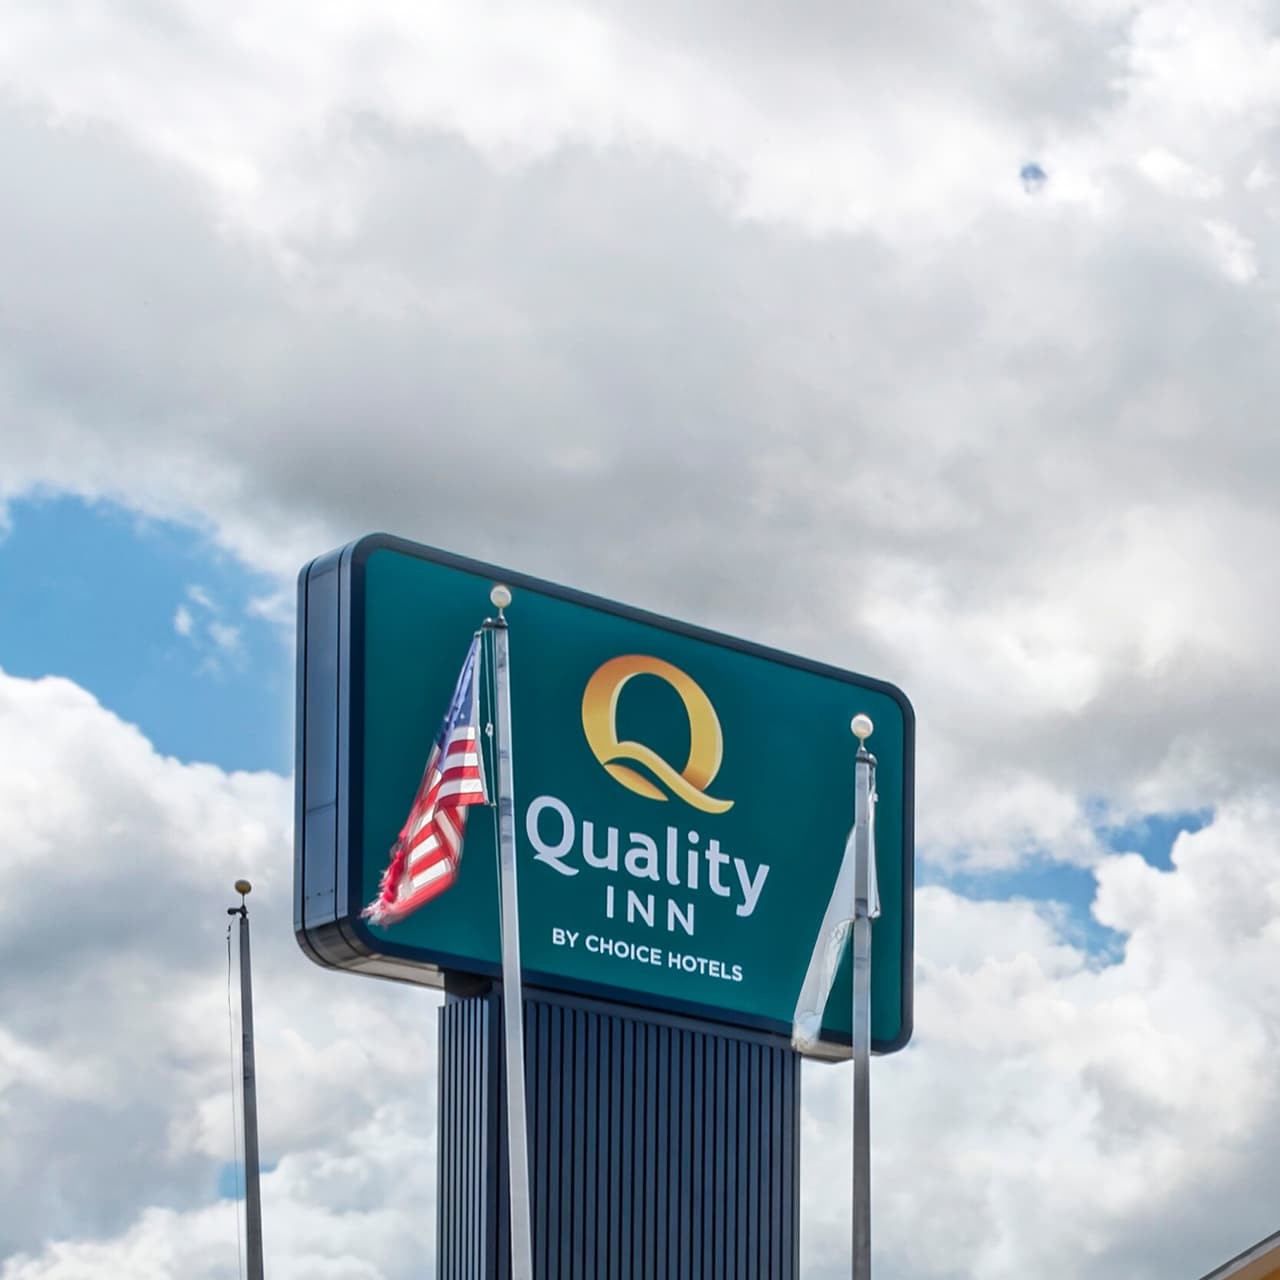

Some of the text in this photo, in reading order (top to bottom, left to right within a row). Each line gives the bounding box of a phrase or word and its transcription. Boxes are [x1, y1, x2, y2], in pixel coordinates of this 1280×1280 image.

[581, 654, 735, 815] Q
[526, 795, 770, 918] Quality
[552, 928, 743, 982] BY CHOICE HOTELS
[605, 885, 696, 937] INN
